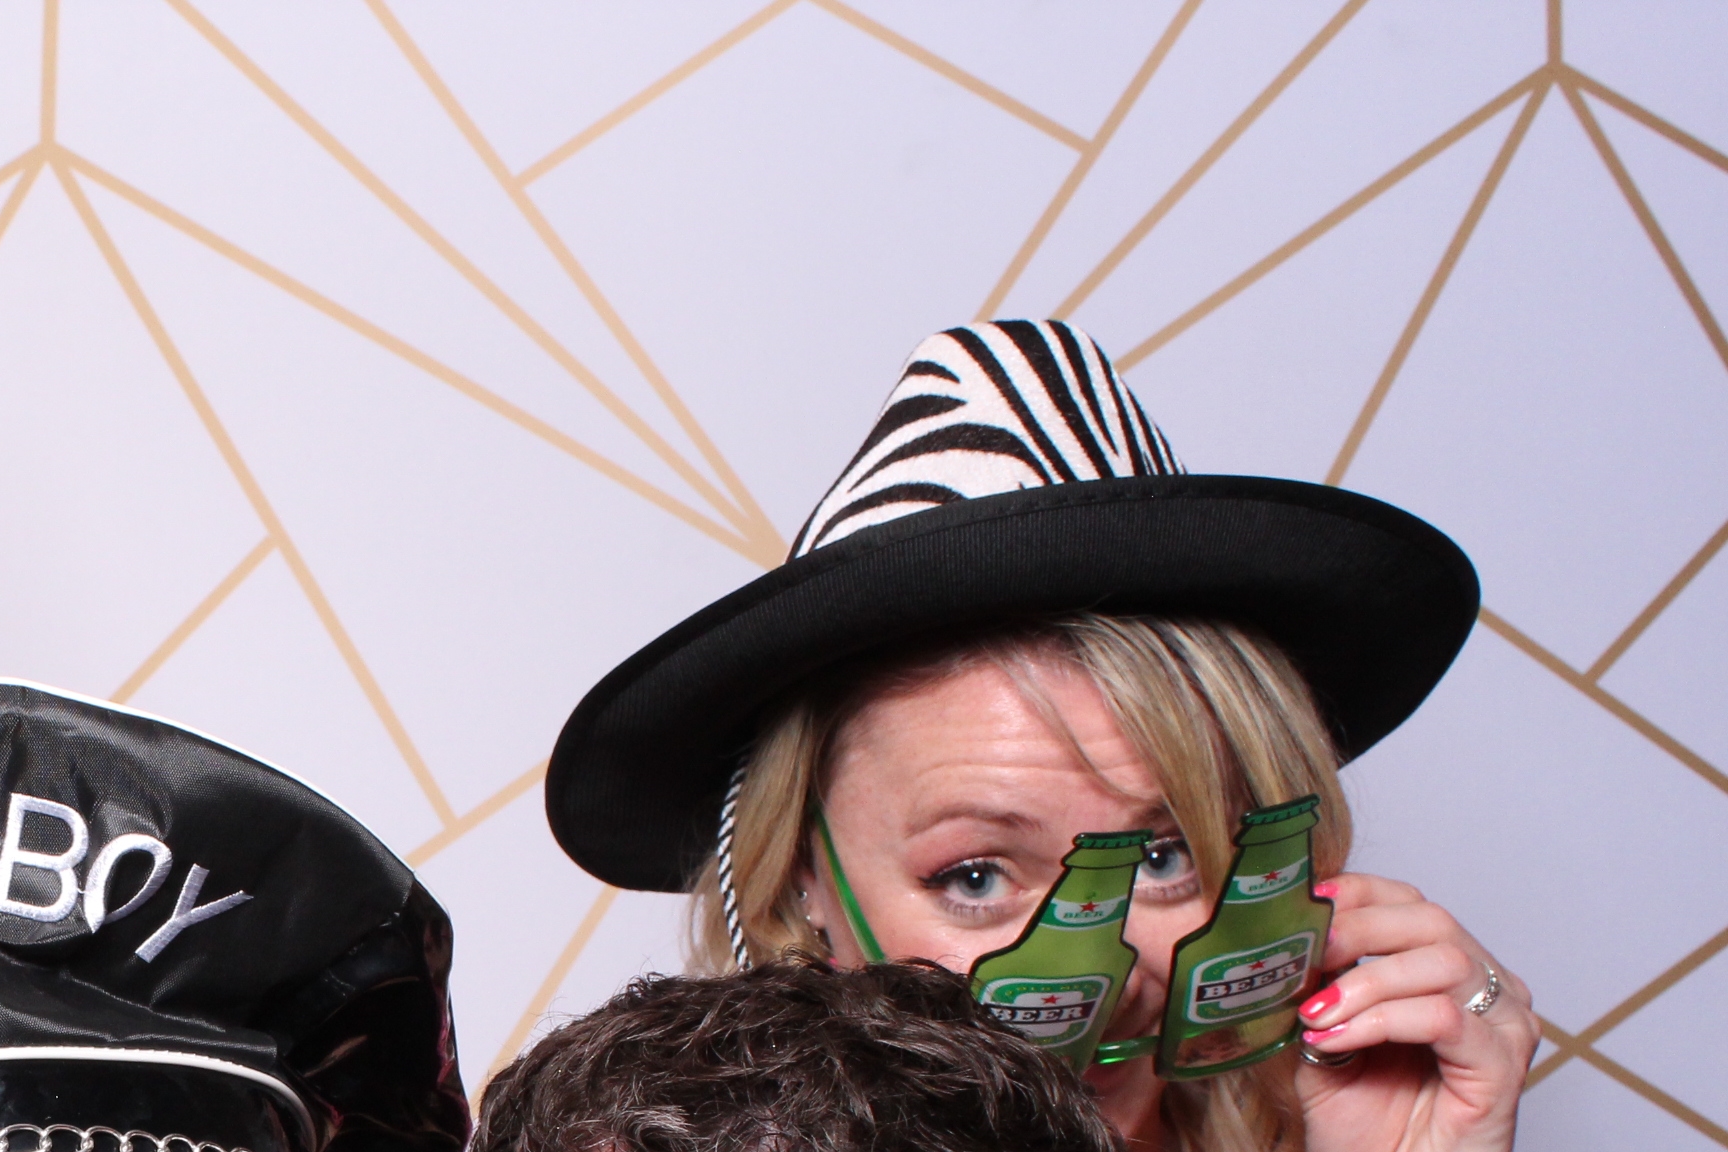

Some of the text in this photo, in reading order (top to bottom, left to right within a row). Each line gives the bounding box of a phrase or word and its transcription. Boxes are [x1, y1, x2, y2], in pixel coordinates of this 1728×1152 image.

[1063, 910, 1104, 919] BEER
[1202, 962, 1298, 1000] BEER
[990, 1005, 1084, 1022] BEER
